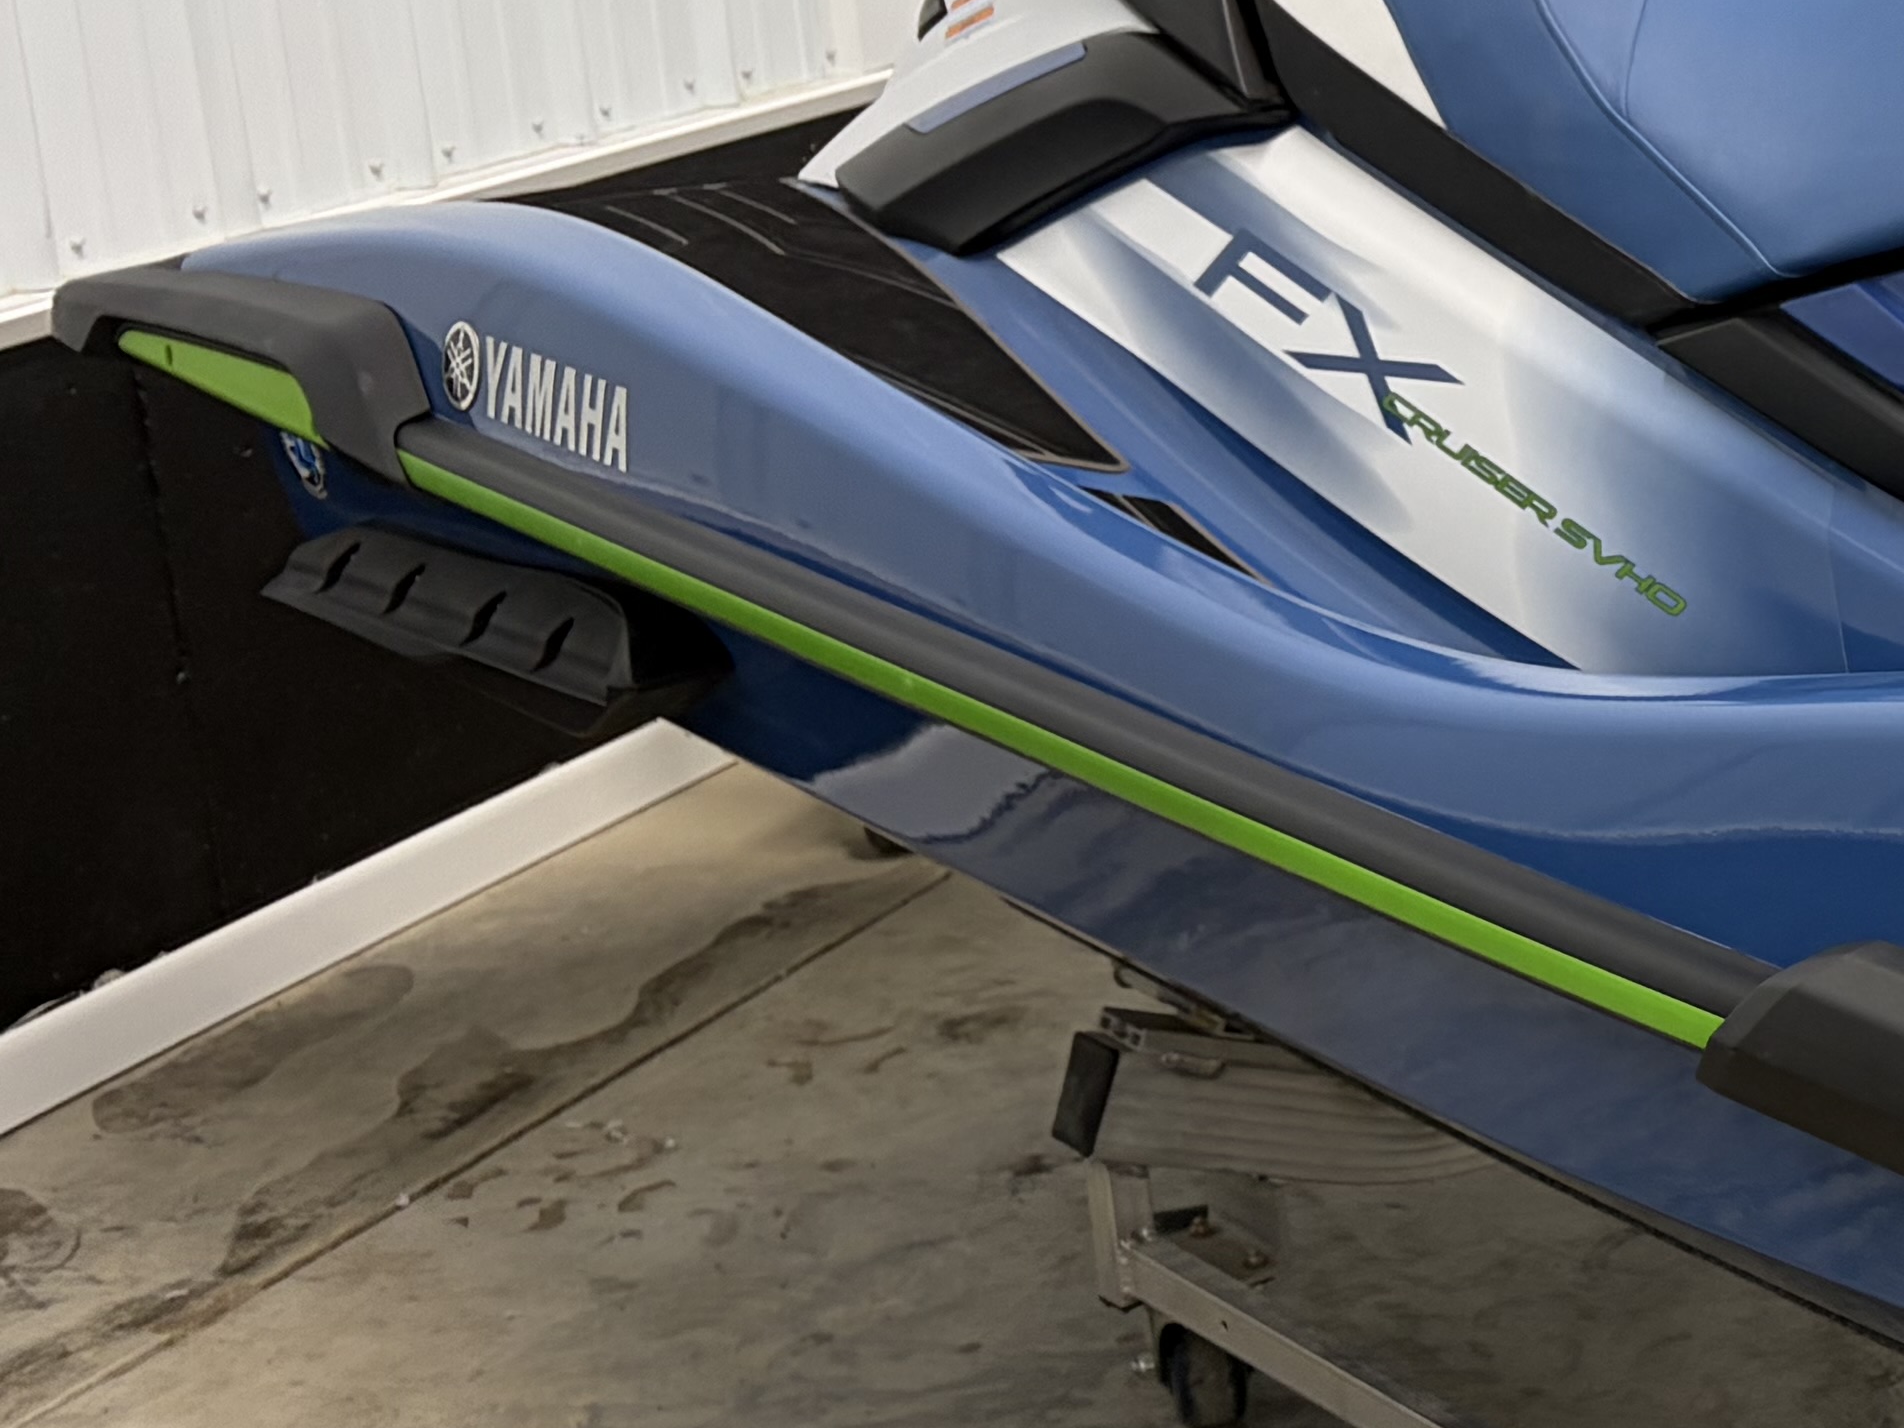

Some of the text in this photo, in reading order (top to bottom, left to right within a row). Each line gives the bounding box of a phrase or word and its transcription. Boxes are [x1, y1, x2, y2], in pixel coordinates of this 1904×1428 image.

[485, 335, 627, 473] YAMAHA
[1193, 229, 1464, 445] FX
[1383, 392, 1687, 616] CRUISER SVHO
